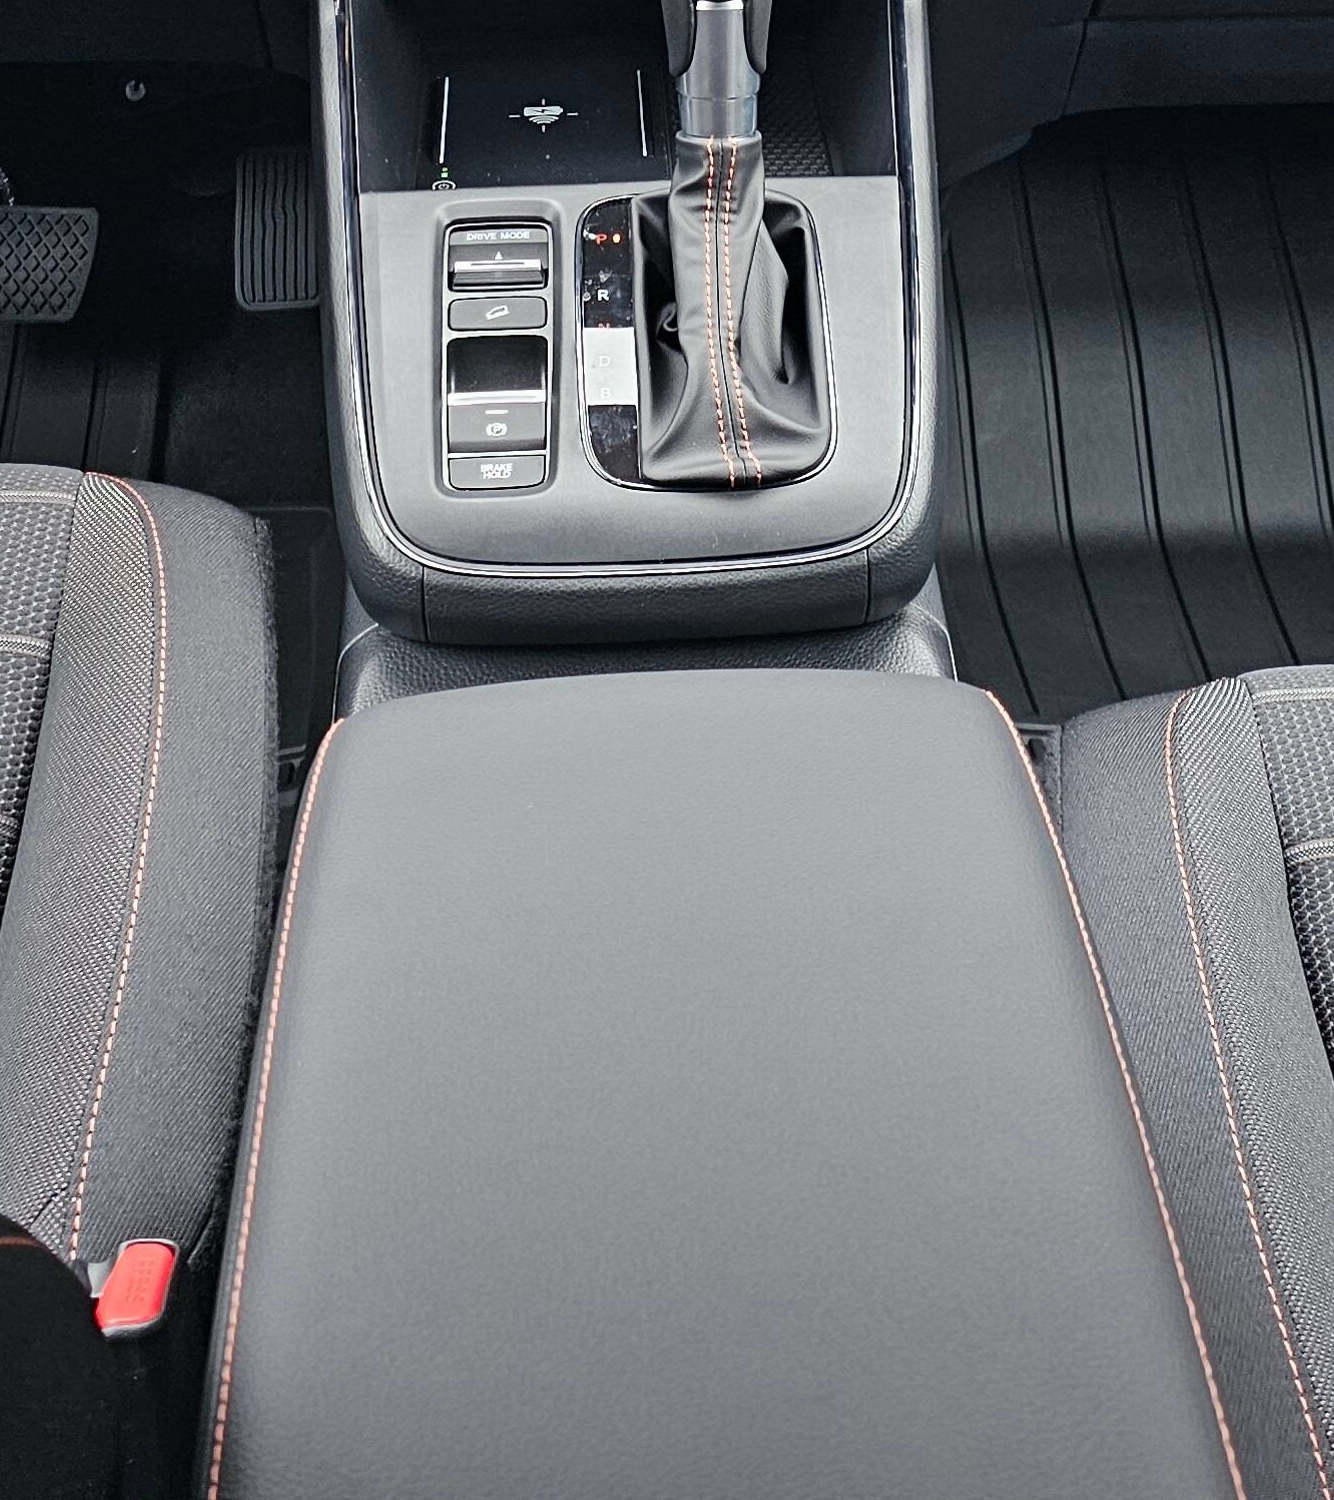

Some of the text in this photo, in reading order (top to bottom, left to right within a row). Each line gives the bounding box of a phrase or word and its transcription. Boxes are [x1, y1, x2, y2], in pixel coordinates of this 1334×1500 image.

[467, 231, 530, 241] DRIVE MODE
[596, 233, 608, 245] P
[597, 289, 610, 301] R
[599, 355, 611, 367] D
[601, 387, 612, 399] B
[480, 463, 513, 472] BRAKE
[483, 470, 512, 479] HOLD
